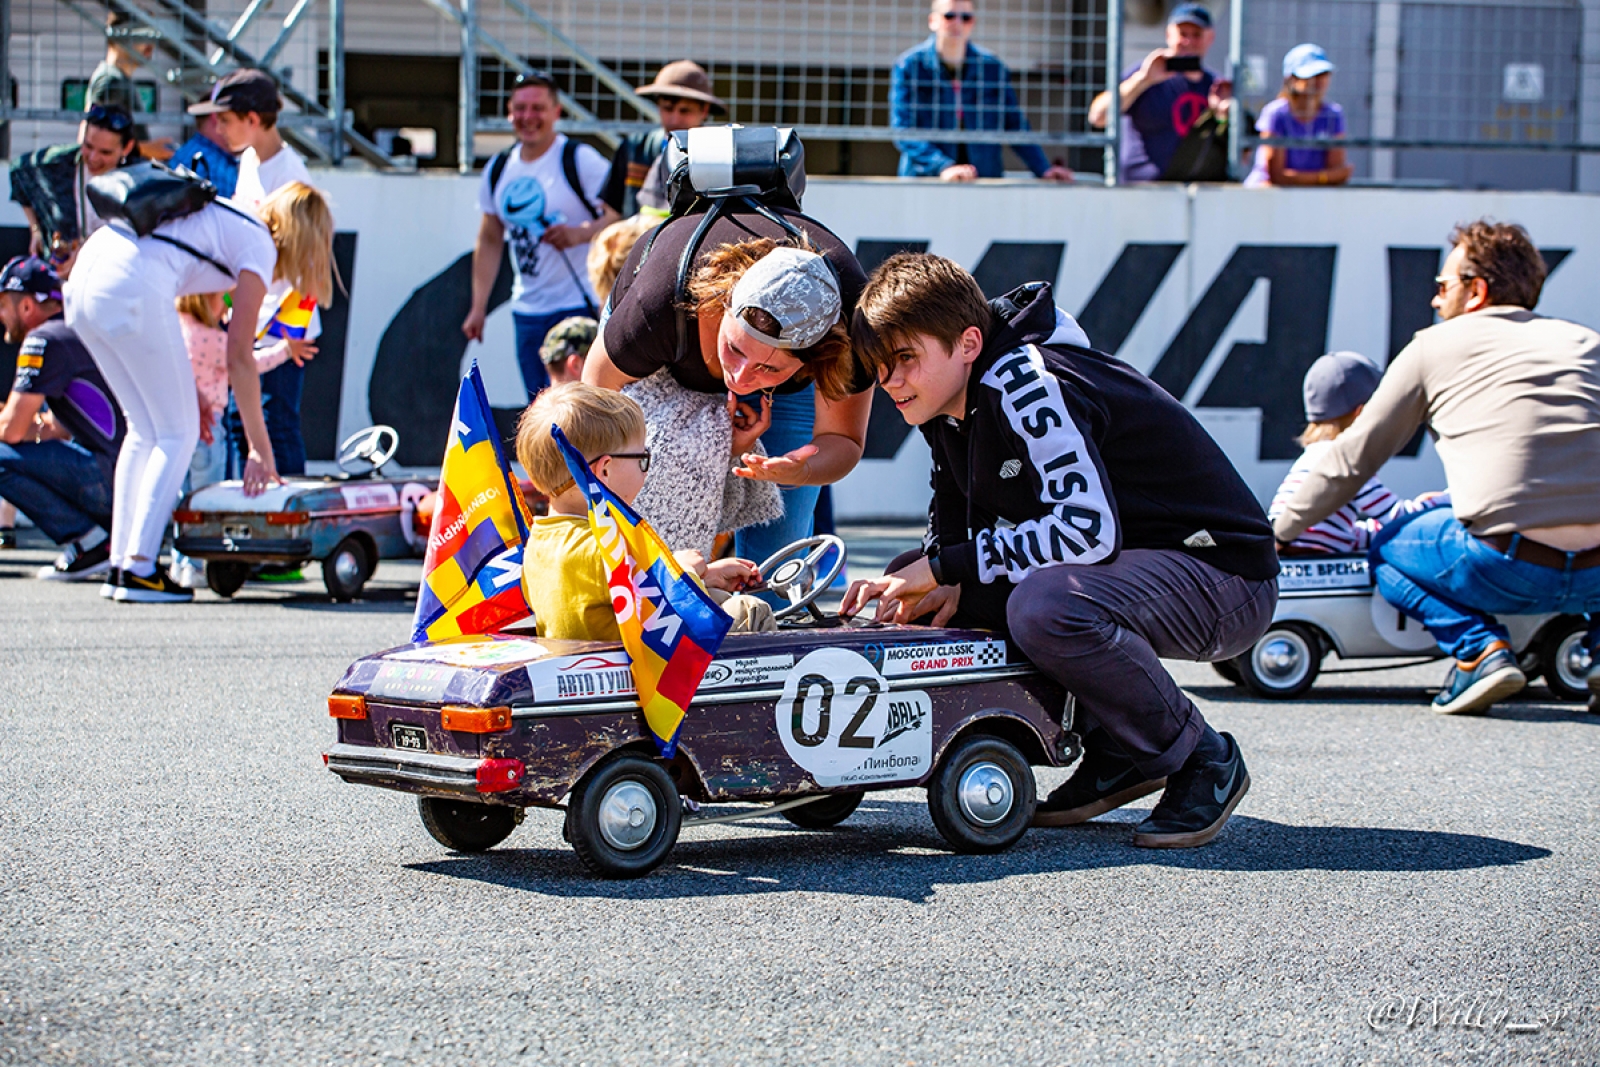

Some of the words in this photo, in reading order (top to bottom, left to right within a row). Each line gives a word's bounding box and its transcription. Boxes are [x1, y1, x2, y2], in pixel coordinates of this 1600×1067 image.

[1043, 450, 1089, 501] IS
[887, 646, 935, 660] MOSCOW
[936, 644, 975, 657] CLASSIC
[911, 659, 948, 671] GRAND
[951, 656, 974, 668] PRIX
[556, 672, 595, 698] АВТО
[791, 673, 882, 749] 02
